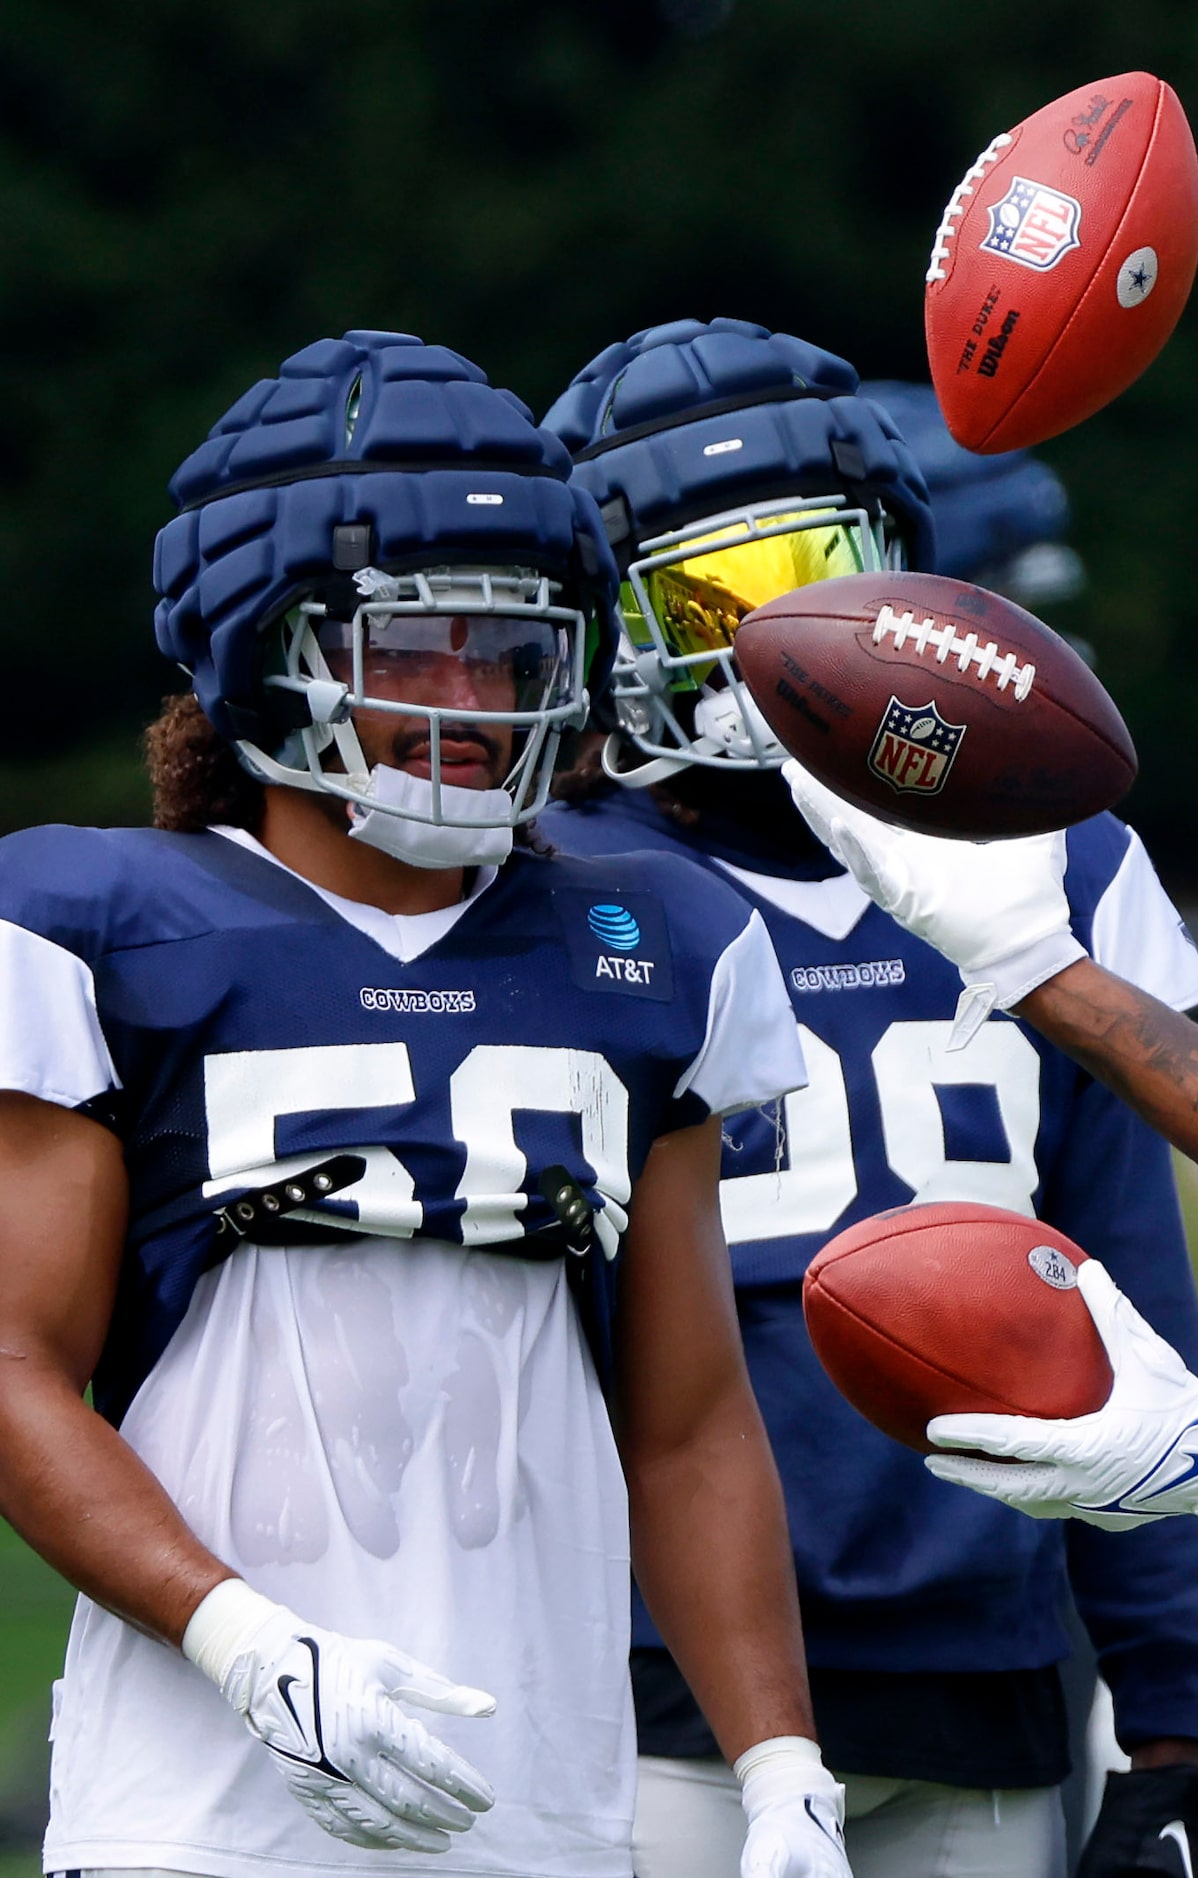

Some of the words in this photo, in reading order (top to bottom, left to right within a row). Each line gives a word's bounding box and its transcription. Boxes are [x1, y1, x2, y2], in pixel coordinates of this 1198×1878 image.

[1015, 200, 1073, 262] NFL
[977, 309, 1020, 378] Wilson
[876, 735, 938, 788] NFL
[595, 955, 654, 986] AT&T
[791, 958, 906, 990] COWBOYS
[360, 987, 476, 1013] COWBOYS
[1045, 1261, 1066, 1283] 284
